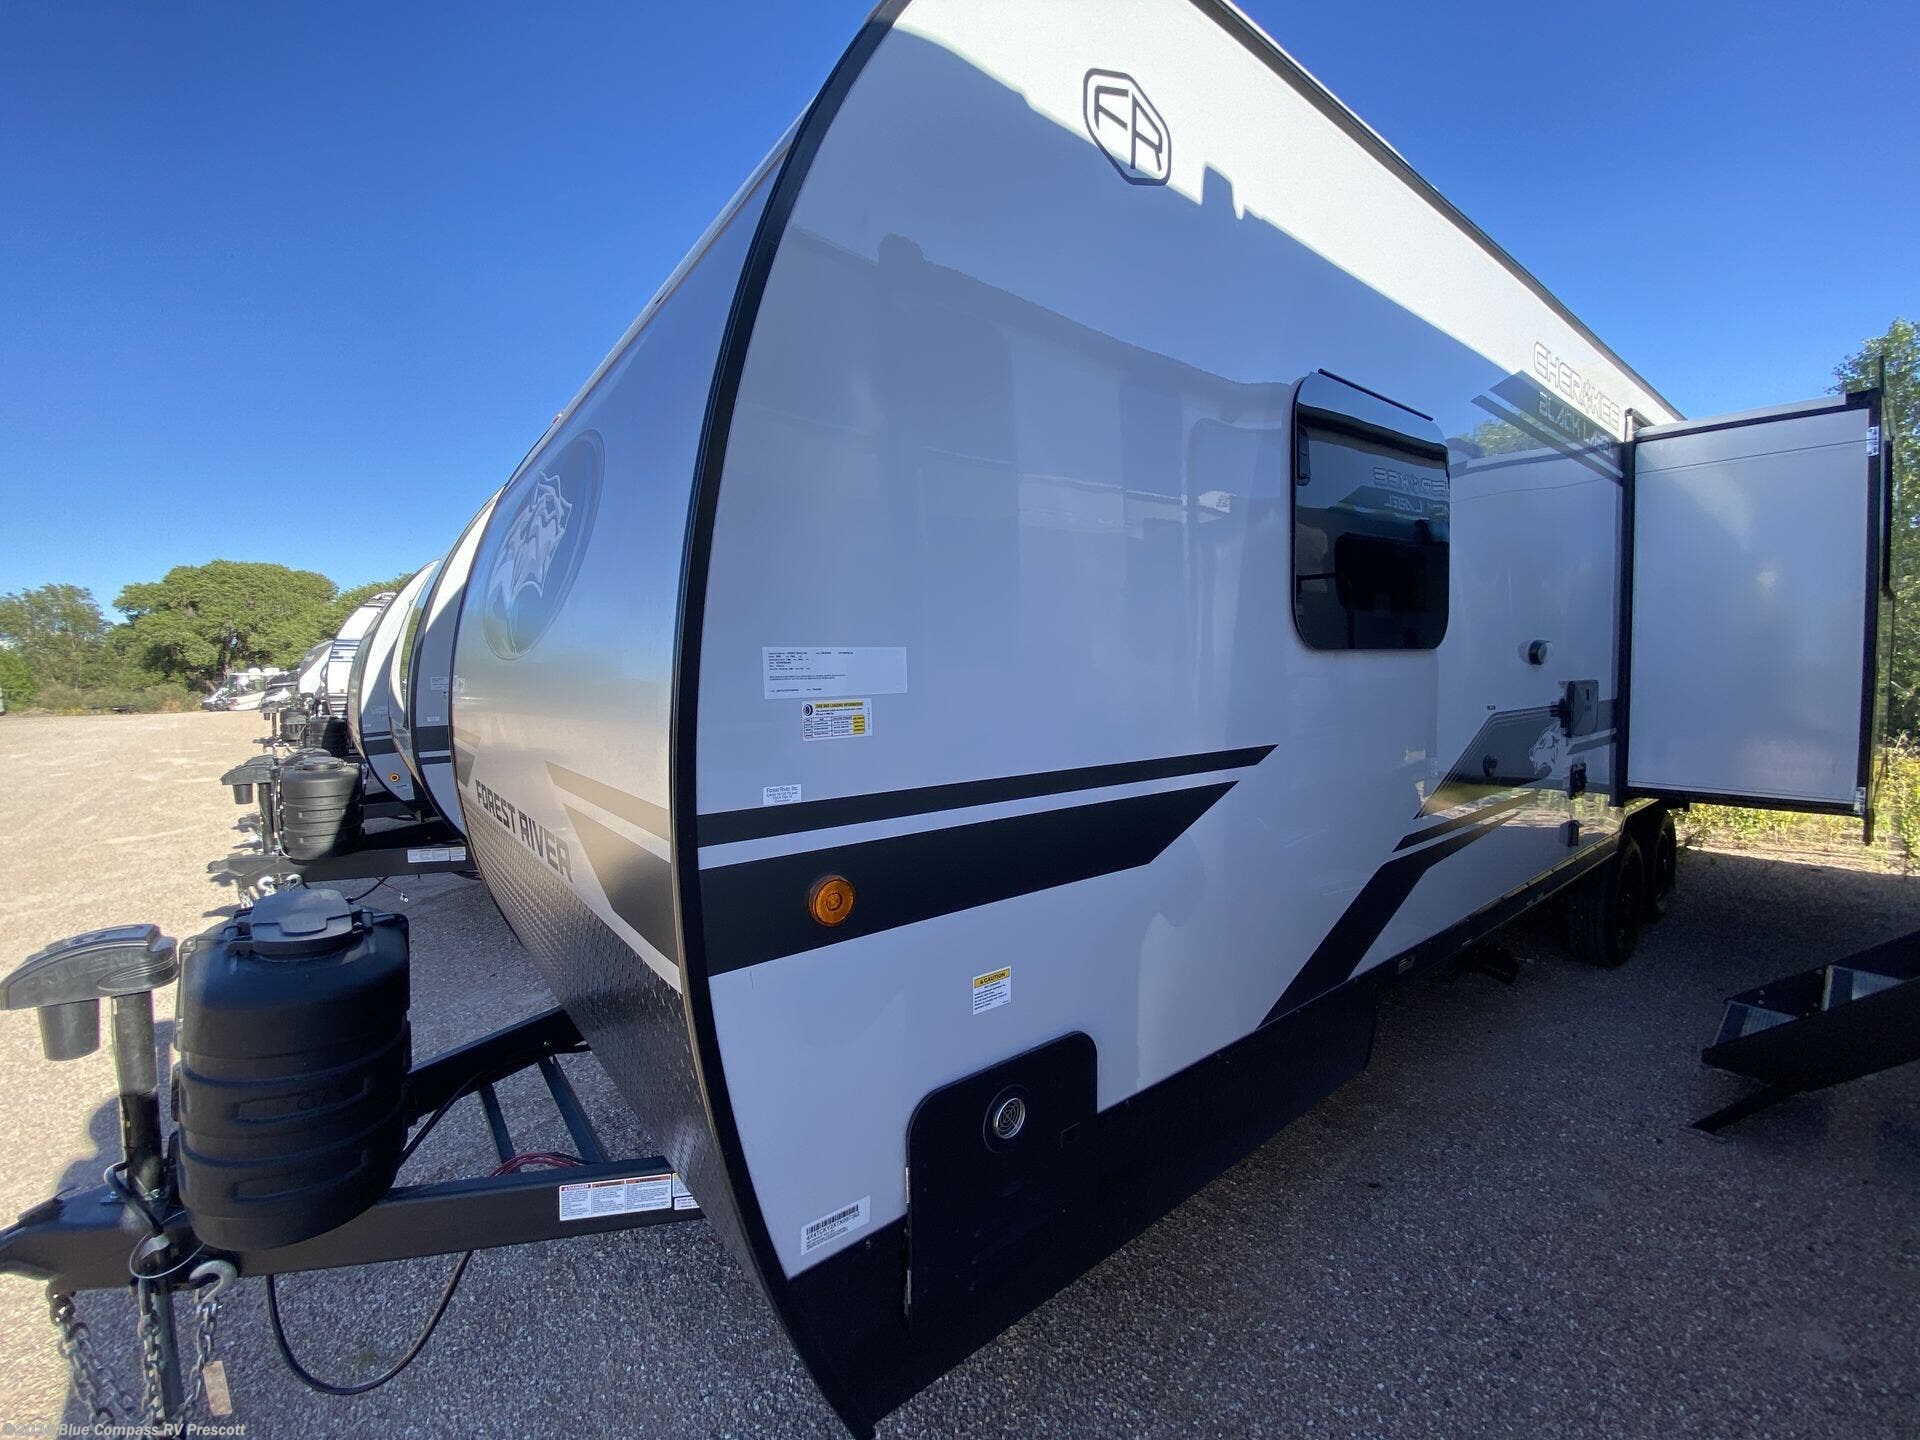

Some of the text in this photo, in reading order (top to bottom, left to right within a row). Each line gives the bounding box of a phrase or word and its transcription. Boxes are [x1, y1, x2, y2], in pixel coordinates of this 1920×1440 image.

[1534, 342, 1620, 432] CHEROKEE
[475, 780, 573, 883] FOREST RIVER
[984, 972, 1006, 983] CAUTION
